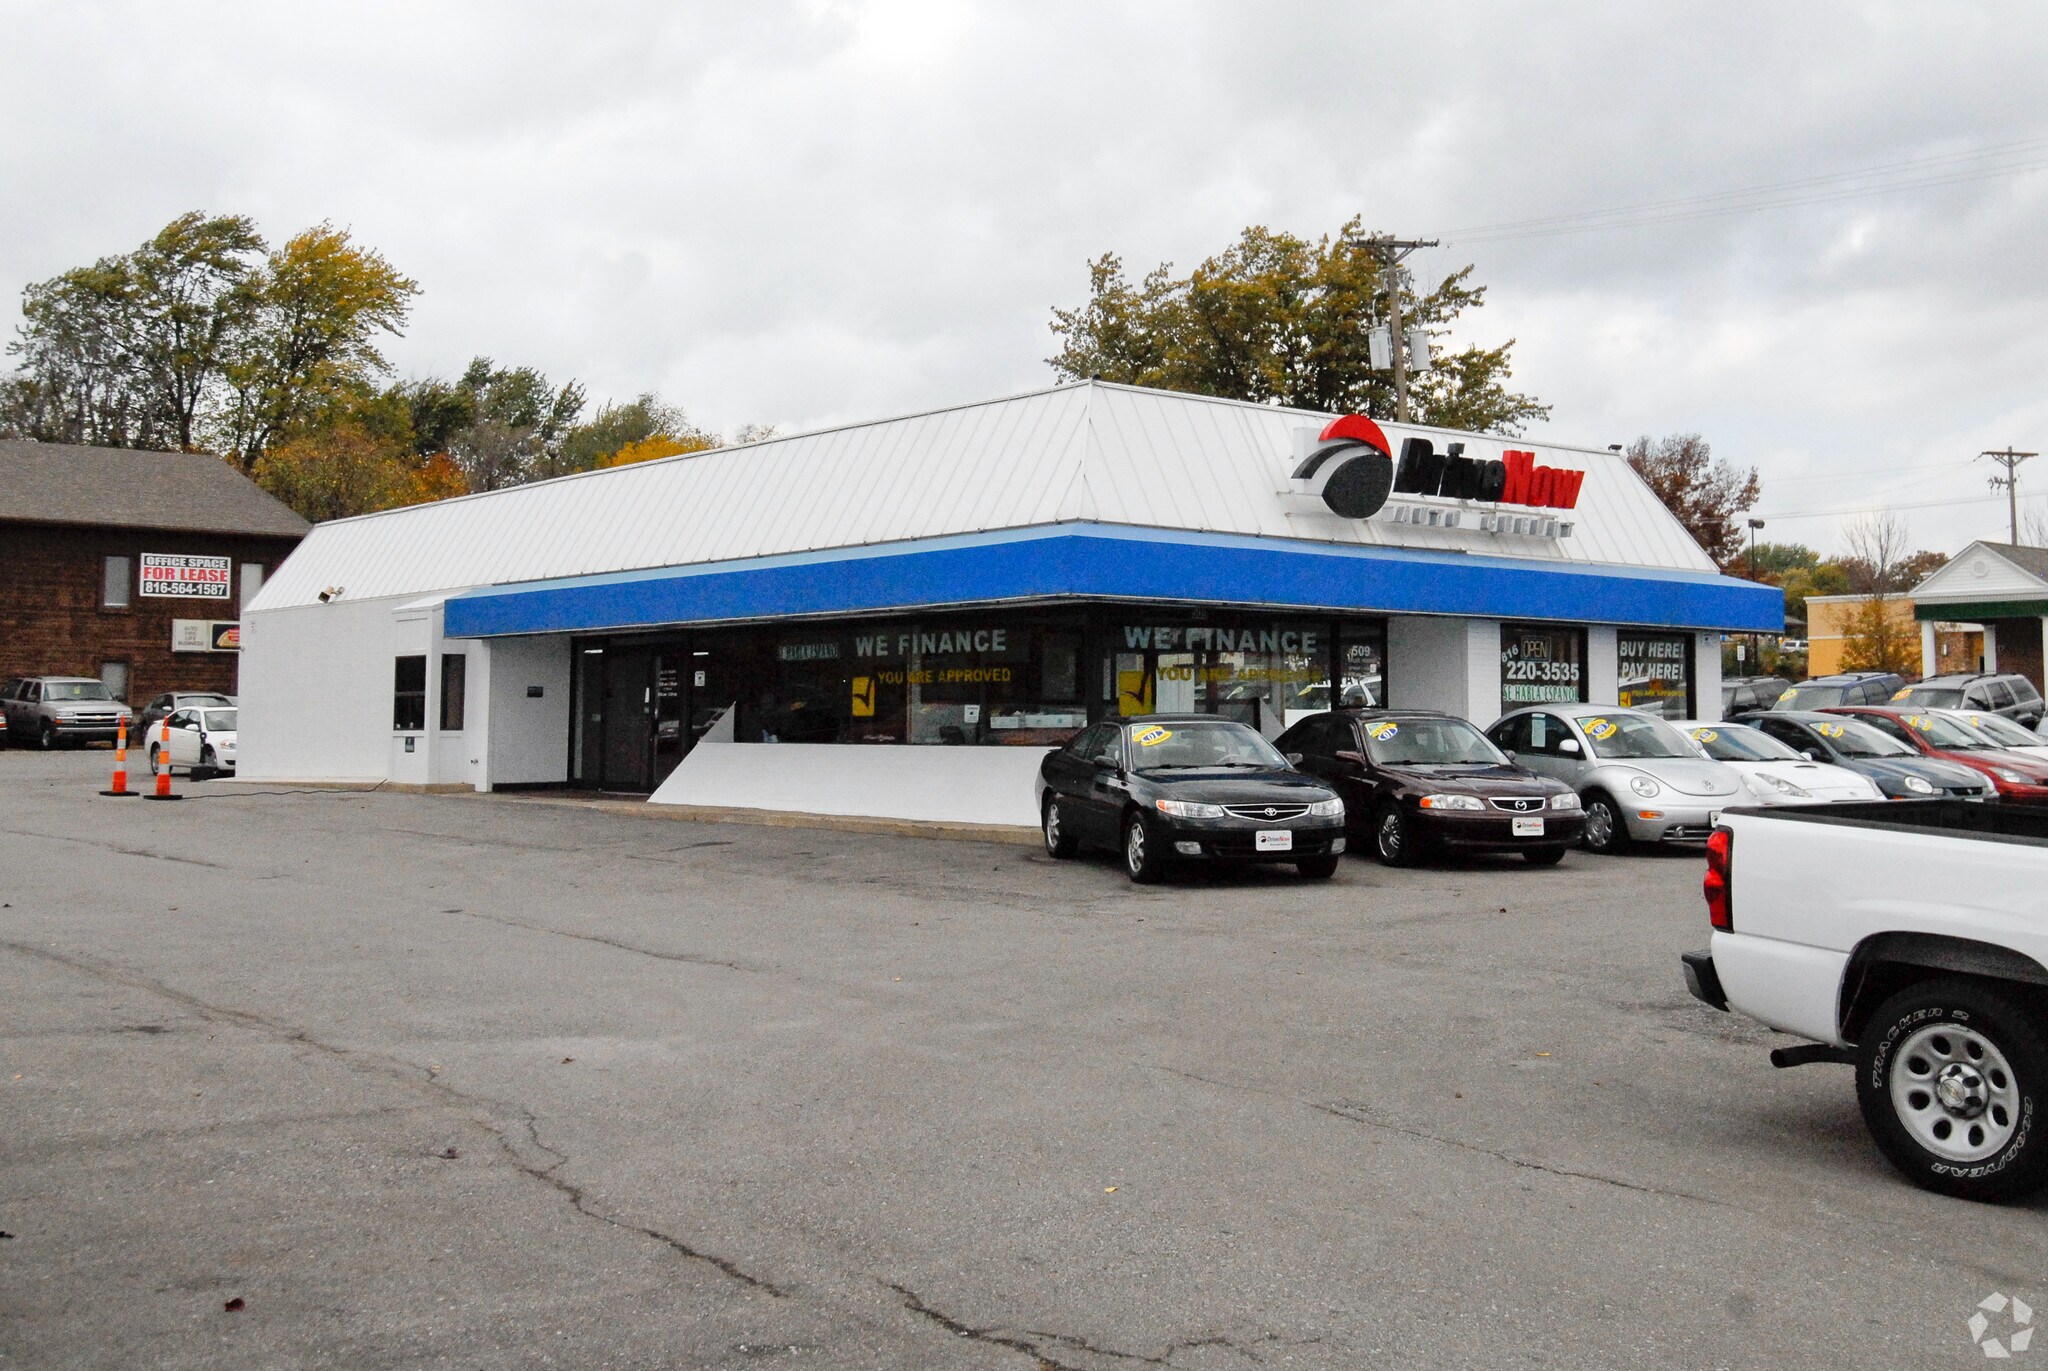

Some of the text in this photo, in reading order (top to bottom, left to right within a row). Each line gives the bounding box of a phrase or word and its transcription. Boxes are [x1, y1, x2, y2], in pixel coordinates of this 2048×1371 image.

[146, 556, 226, 569] OFFICE SPACE
[143, 567, 228, 582] FOR LEASE
[145, 582, 225, 595] 816-564-1587
[855, 635, 889, 657] WE
[898, 629, 1007, 656] FINANCE
[1124, 625, 1318, 654] WE FINANCE
[1351, 645, 1370, 657] 509
[1501, 645, 1519, 663] 816
[1523, 640, 1548, 659] OPEN
[1619, 641, 1685, 658] BUY HERE!
[878, 667, 1011, 684] YOU ARE APPROVED
[1157, 666, 1192, 681] YOU
[1506, 661, 1580, 681] 220-3535
[1621, 662, 1683, 680] PAY HERE!
[1873, 1007, 1943, 1089] TRACKER
